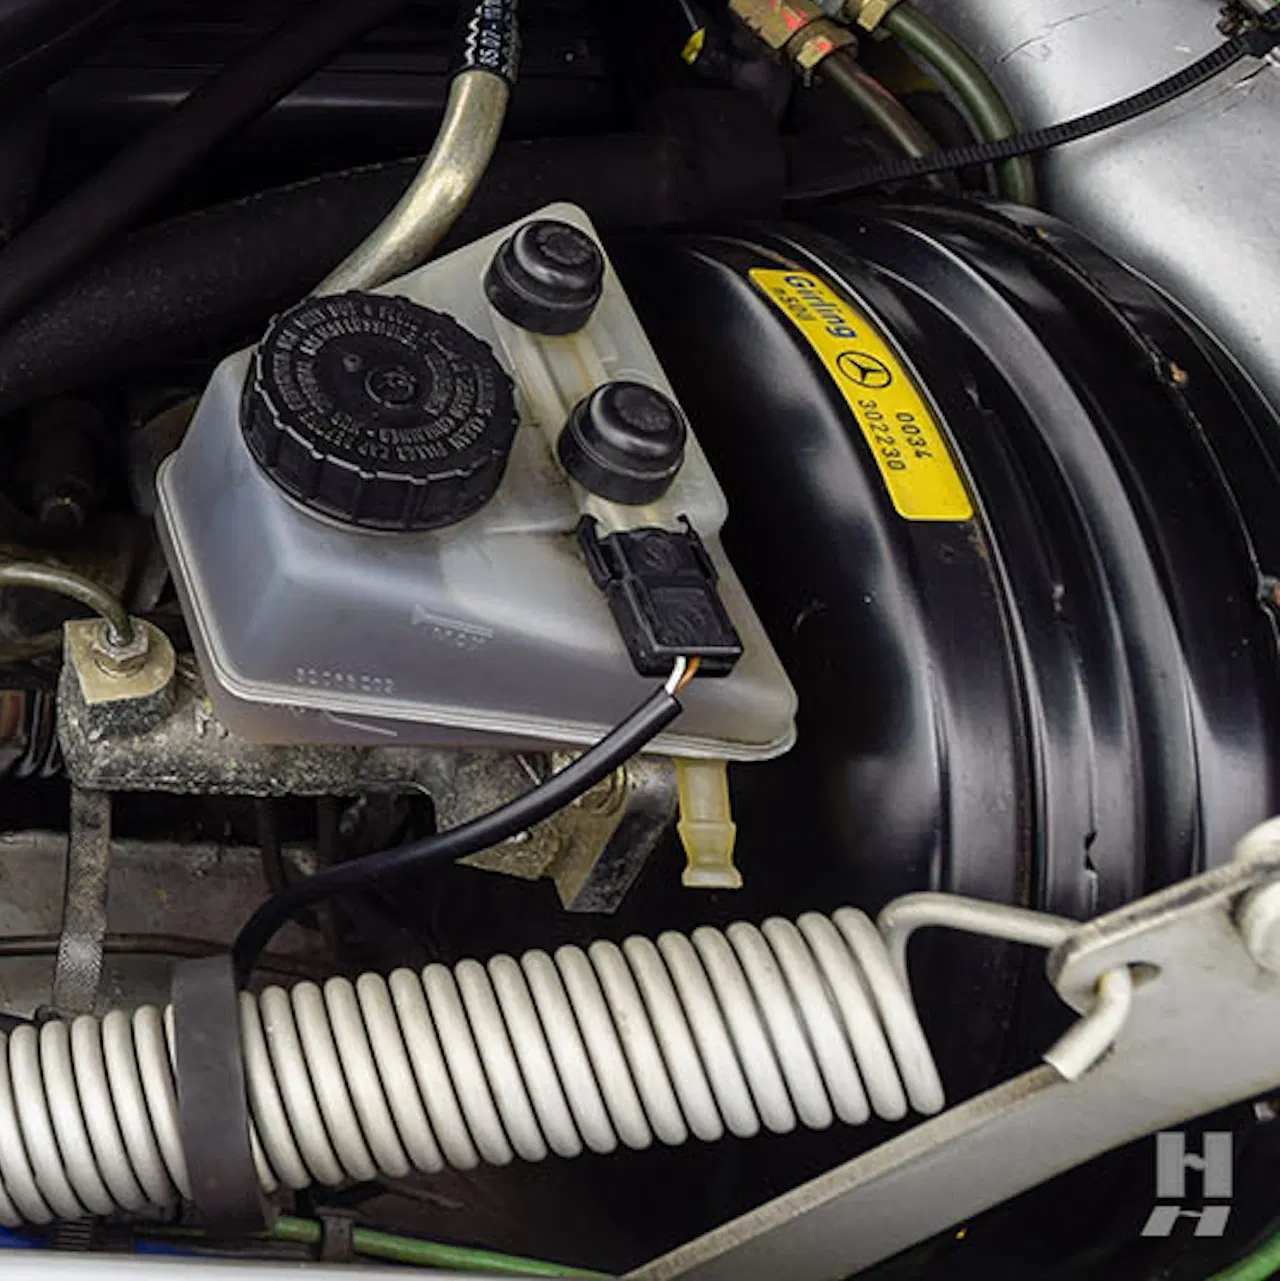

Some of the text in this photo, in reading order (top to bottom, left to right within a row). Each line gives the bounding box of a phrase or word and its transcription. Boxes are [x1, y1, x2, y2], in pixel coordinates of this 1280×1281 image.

[783, 274, 858, 338] Girling
[857, 399, 906, 471] 302230
[895, 411, 934, 459] 0034
